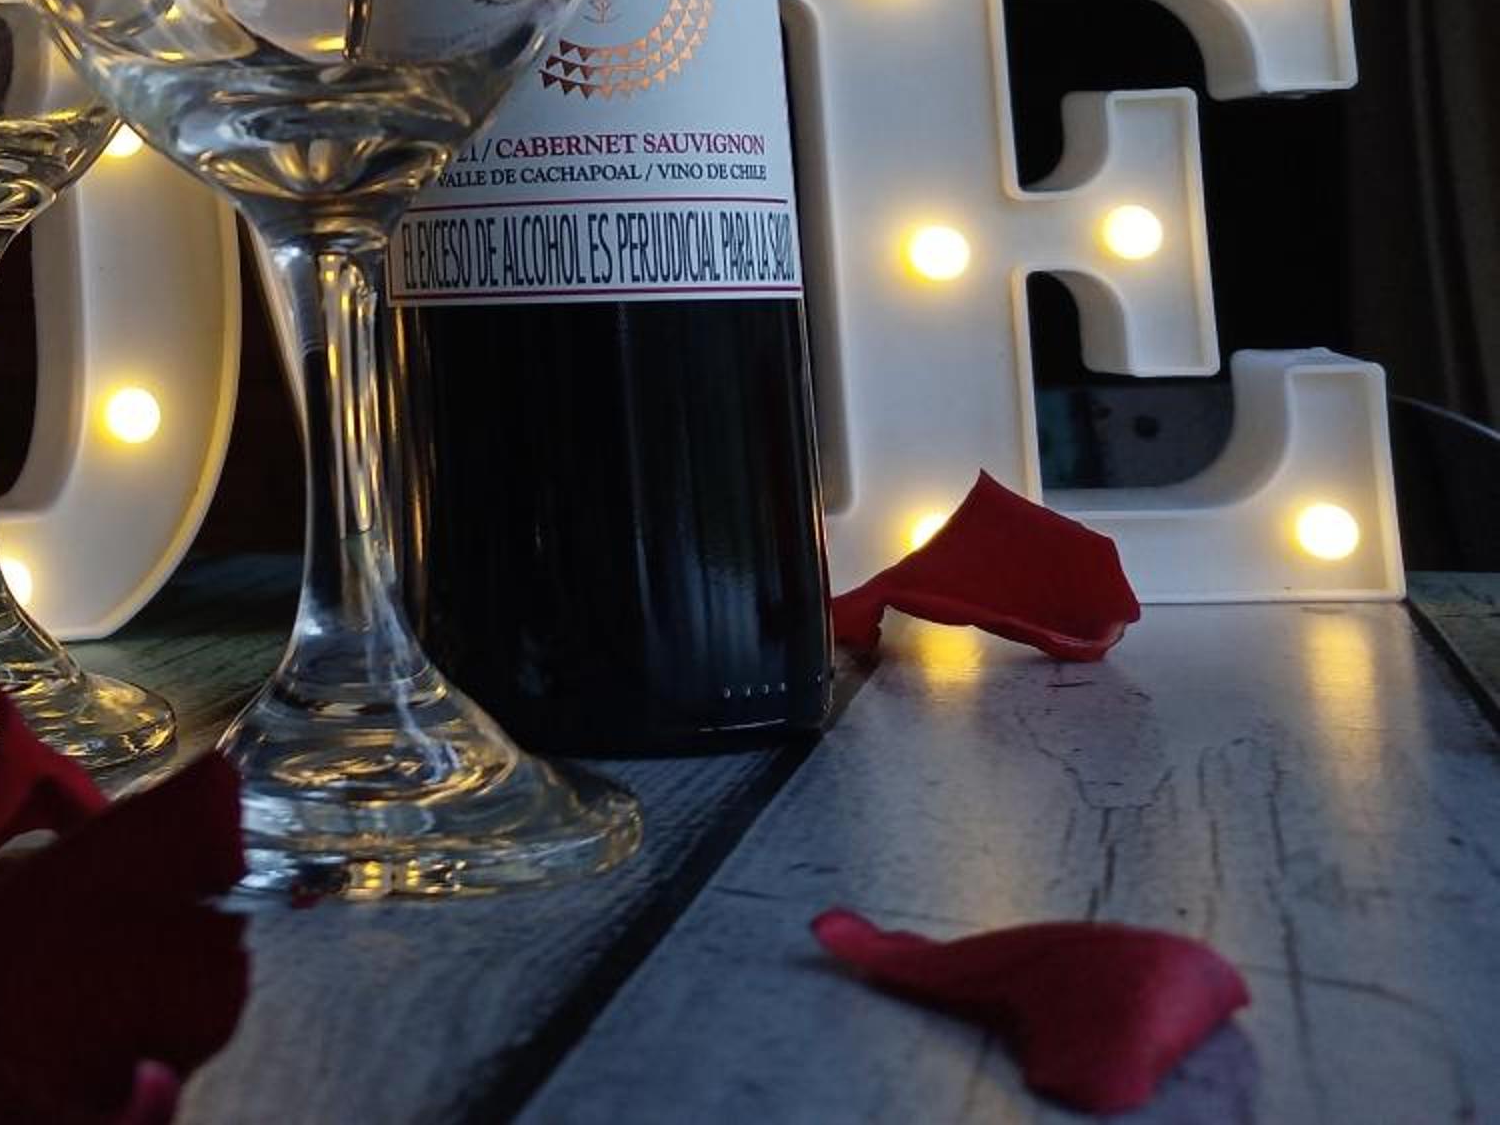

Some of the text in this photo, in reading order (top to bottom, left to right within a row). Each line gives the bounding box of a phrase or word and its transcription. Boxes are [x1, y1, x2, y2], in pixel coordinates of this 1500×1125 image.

[495, 134, 638, 159] CABERNET
[642, 131, 765, 155] SAUVIGNON
[490, 167, 517, 186] DE
[520, 163, 643, 185] CACHAPOAL
[656, 162, 704, 180] VINO
[706, 162, 729, 180] DE
[730, 163, 767, 181] CHILE
[402, 223, 417, 289] EL
[417, 218, 471, 289] EXCESO
[475, 217, 499, 286] DE
[503, 213, 587, 286] ALCOHOL
[588, 212, 613, 284] ES
[615, 211, 720, 283] PERJUDICIAL
[719, 211, 757, 281] PARA
[752, 211, 771, 281] LA
